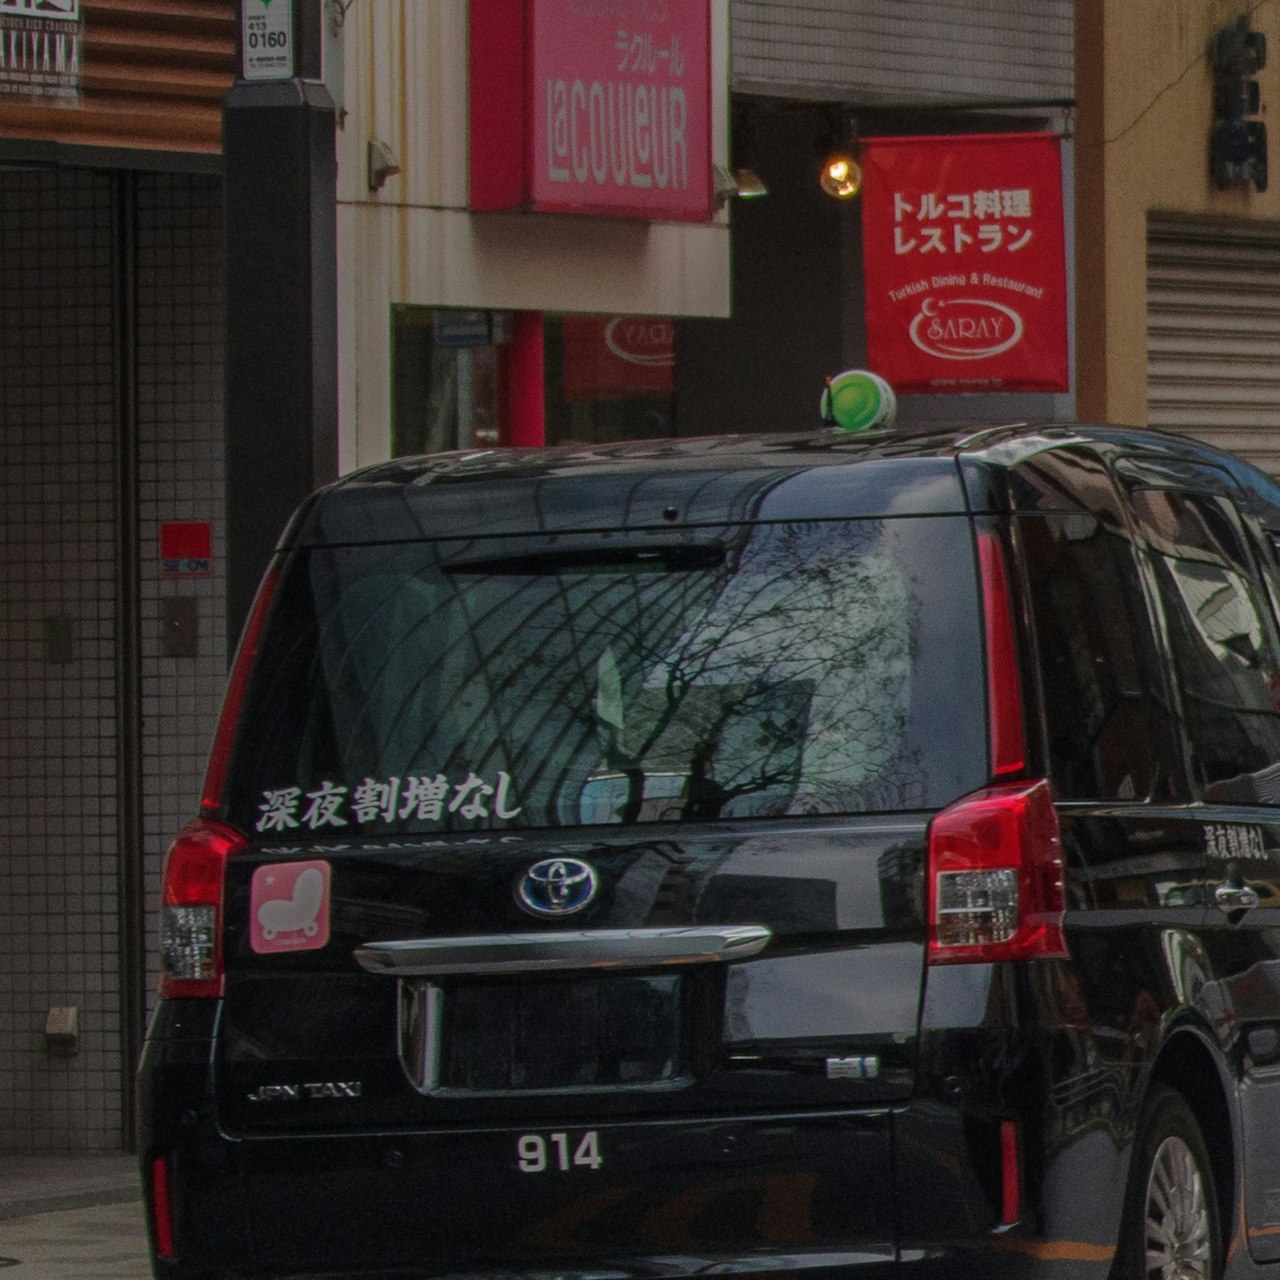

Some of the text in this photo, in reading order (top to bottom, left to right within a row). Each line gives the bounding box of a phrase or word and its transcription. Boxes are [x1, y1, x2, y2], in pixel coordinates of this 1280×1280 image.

[249, 22, 266, 31] 413
[249, 31, 287, 48] 0160
[893, 188, 1033, 222] トルコ料理
[893, 223, 1034, 255] レストラン
[888, 271, 1045, 303] Turkish Dining & Restaurant
[926, 316, 1003, 340] SARAY
[256, 771, 523, 833] 深夜割増なし
[303, 1081, 361, 1099] TAXI
[517, 1131, 603, 1173] 914
